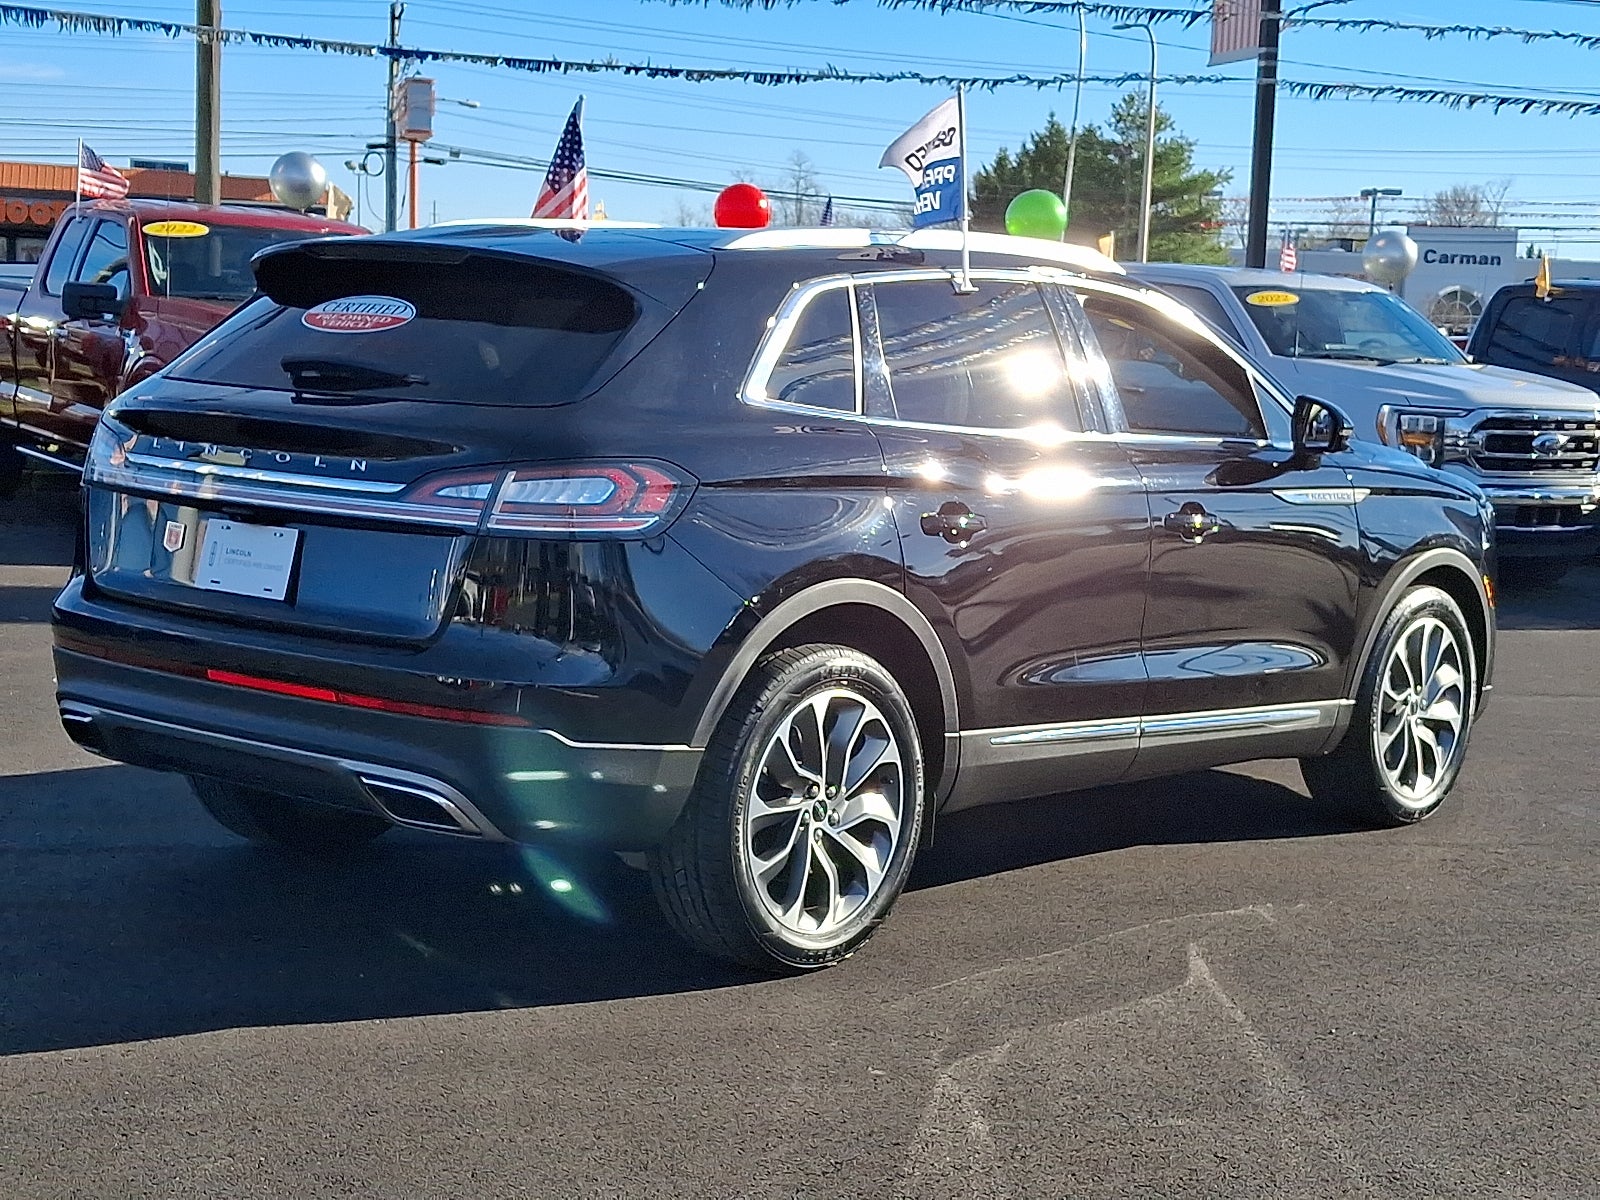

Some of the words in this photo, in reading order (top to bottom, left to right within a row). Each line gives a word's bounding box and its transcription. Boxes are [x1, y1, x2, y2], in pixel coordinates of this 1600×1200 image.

[1423, 248, 1502, 266] Carman
[322, 302, 409, 315] CERTIFIED
[316, 313, 393, 323] PRE-OWNED
[322, 320, 374, 328] VEHICLE
[152, 437, 368, 472] LINCOLN
[225, 547, 252, 557] LINCOLN
